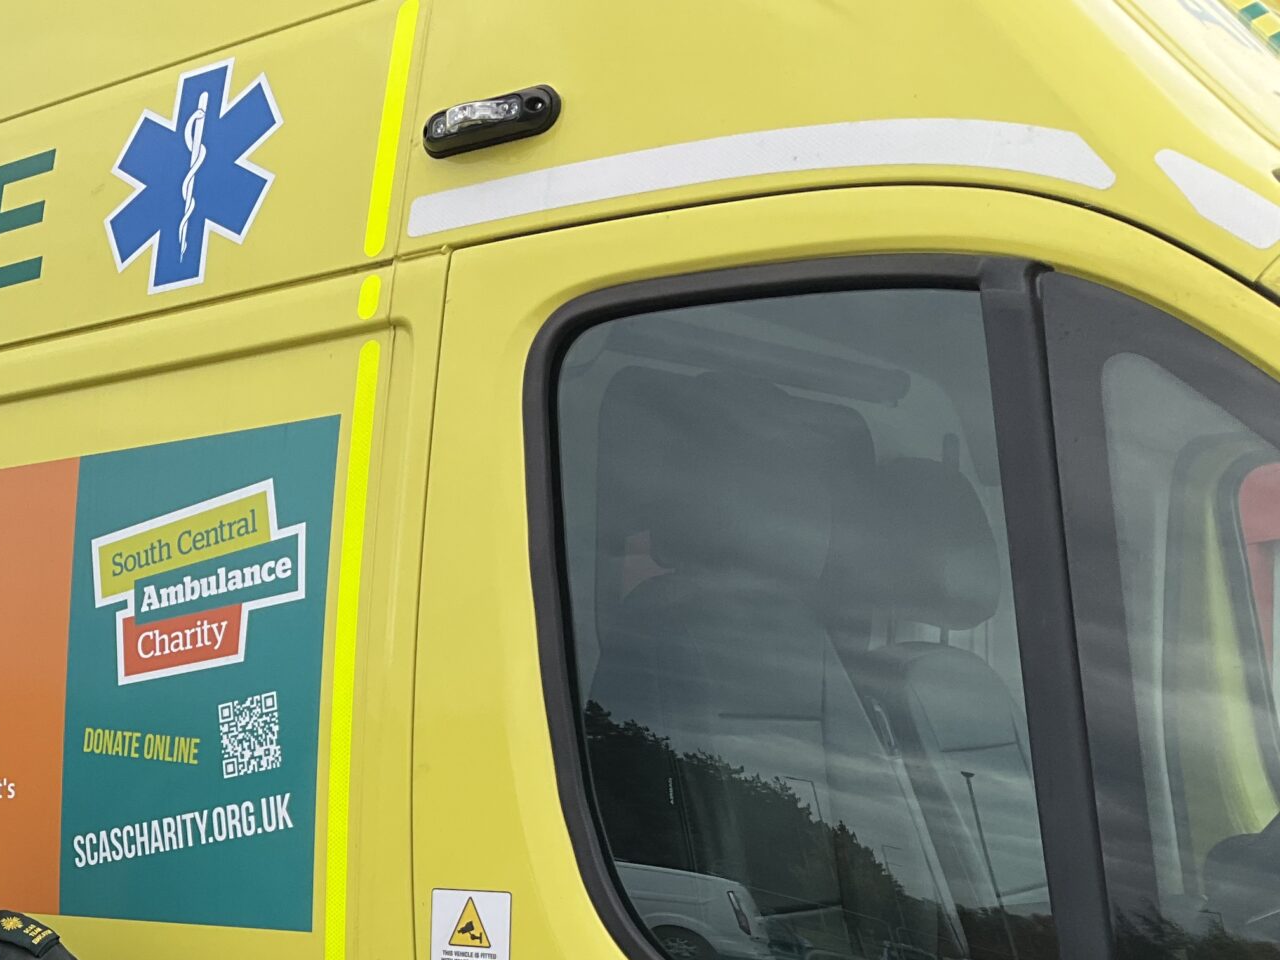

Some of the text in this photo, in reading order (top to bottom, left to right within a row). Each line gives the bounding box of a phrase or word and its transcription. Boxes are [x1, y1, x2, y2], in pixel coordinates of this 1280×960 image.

[111, 509, 258, 577] South Central
[140, 556, 293, 613] Ambulance
[137, 617, 228, 659] Charity
[83, 727, 201, 765] DONATE ONLINE
[73, 793, 293, 868] SCASCHARITY.ORG.UK
